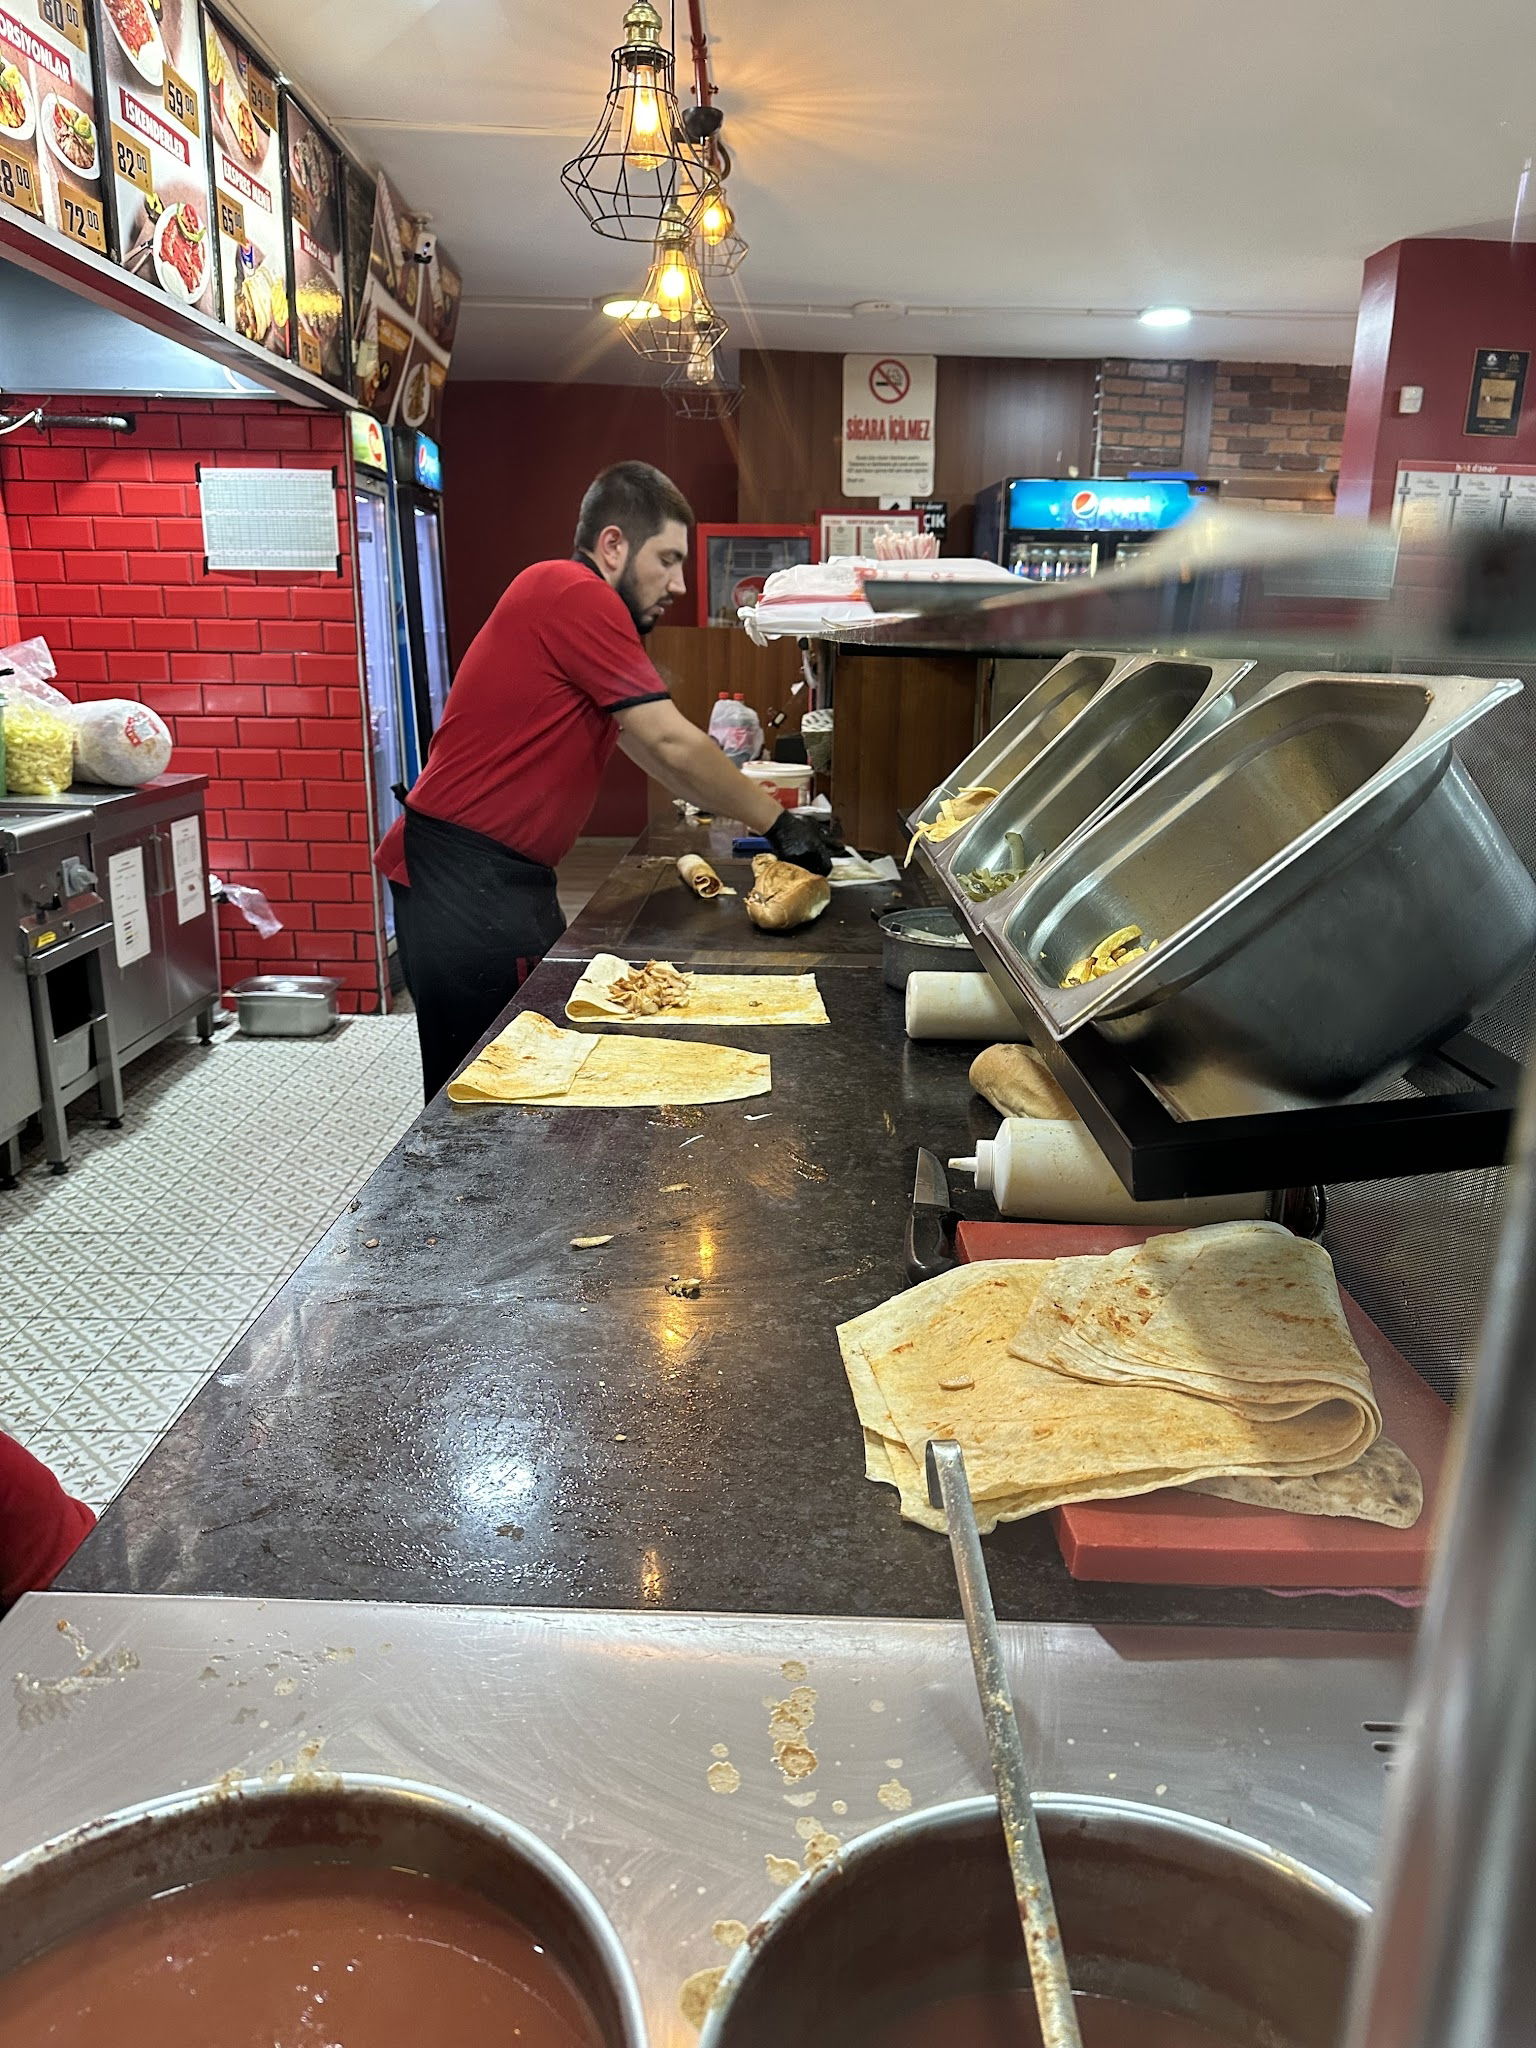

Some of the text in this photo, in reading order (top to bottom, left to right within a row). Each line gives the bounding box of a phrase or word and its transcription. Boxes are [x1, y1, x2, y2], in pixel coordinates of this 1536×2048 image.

[168, 80, 183, 119] 59
[0, 159, 15, 198] 8
[117, 141, 136, 179] 82
[64, 199, 87, 238] 72
[222, 204, 234, 235] 65
[847, 414, 931, 445] SİGARA İÇİLMEZ
